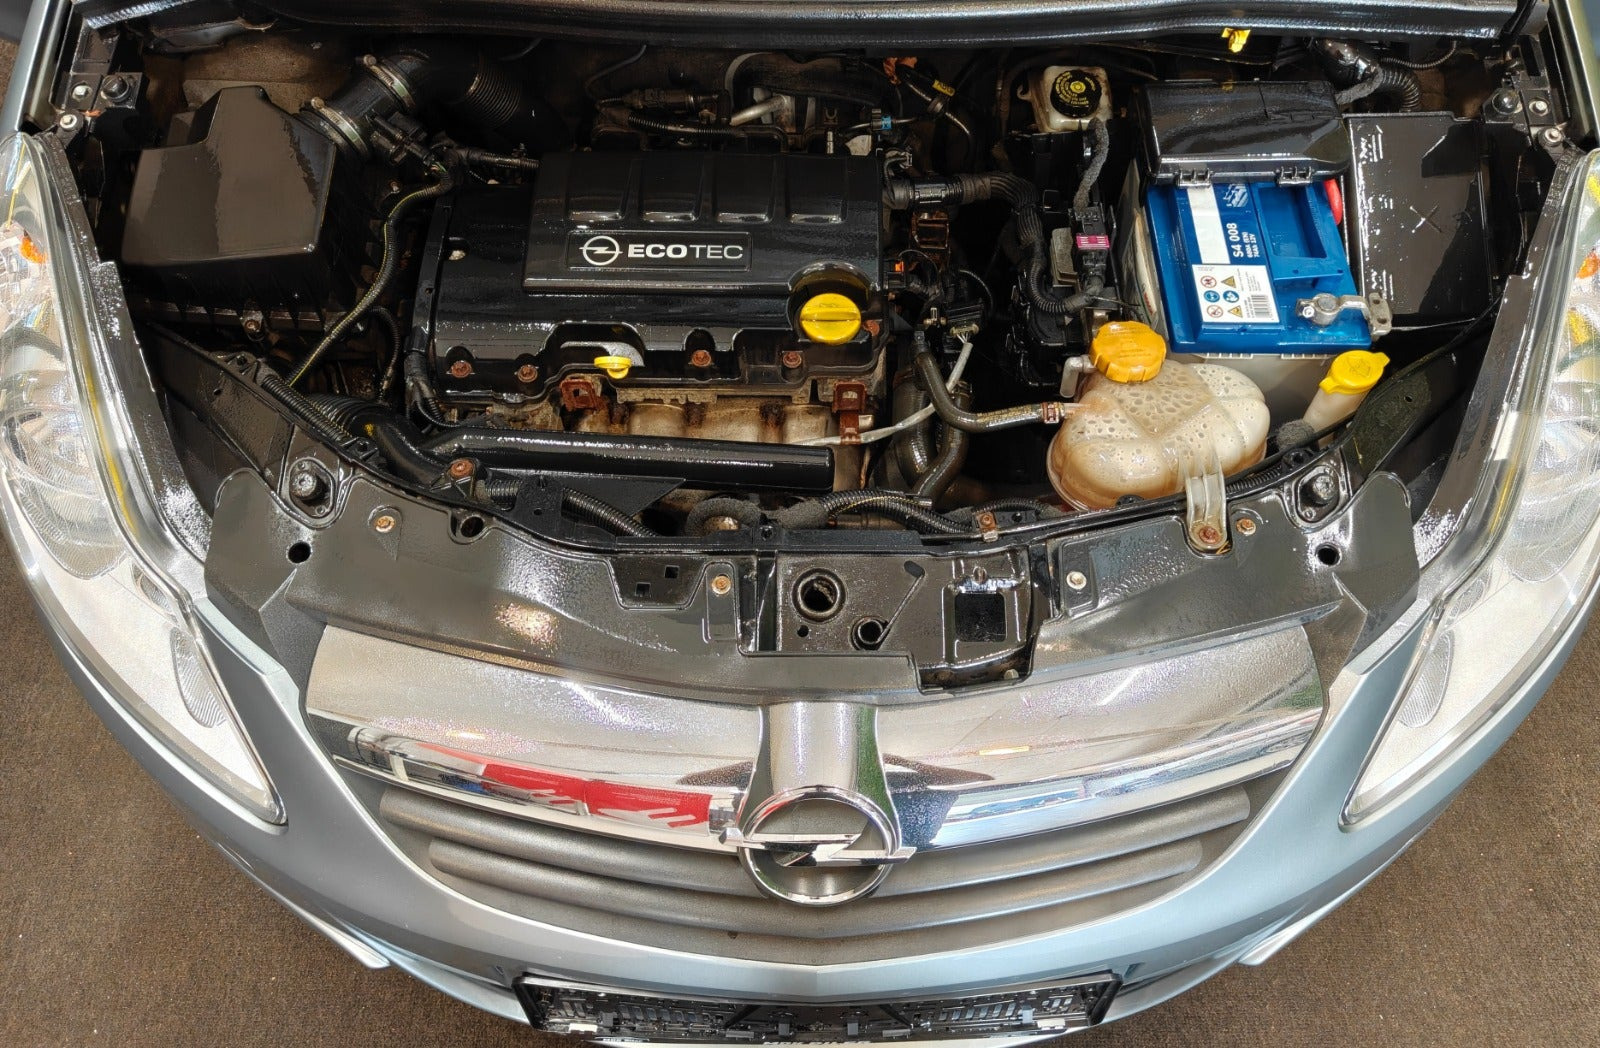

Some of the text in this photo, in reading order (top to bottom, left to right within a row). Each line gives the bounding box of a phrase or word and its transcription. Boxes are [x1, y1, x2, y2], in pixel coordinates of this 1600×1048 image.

[1226, 222, 1240, 242] 008
[627, 244, 744, 259] ECOTEC
[1231, 244, 1244, 257] S4
